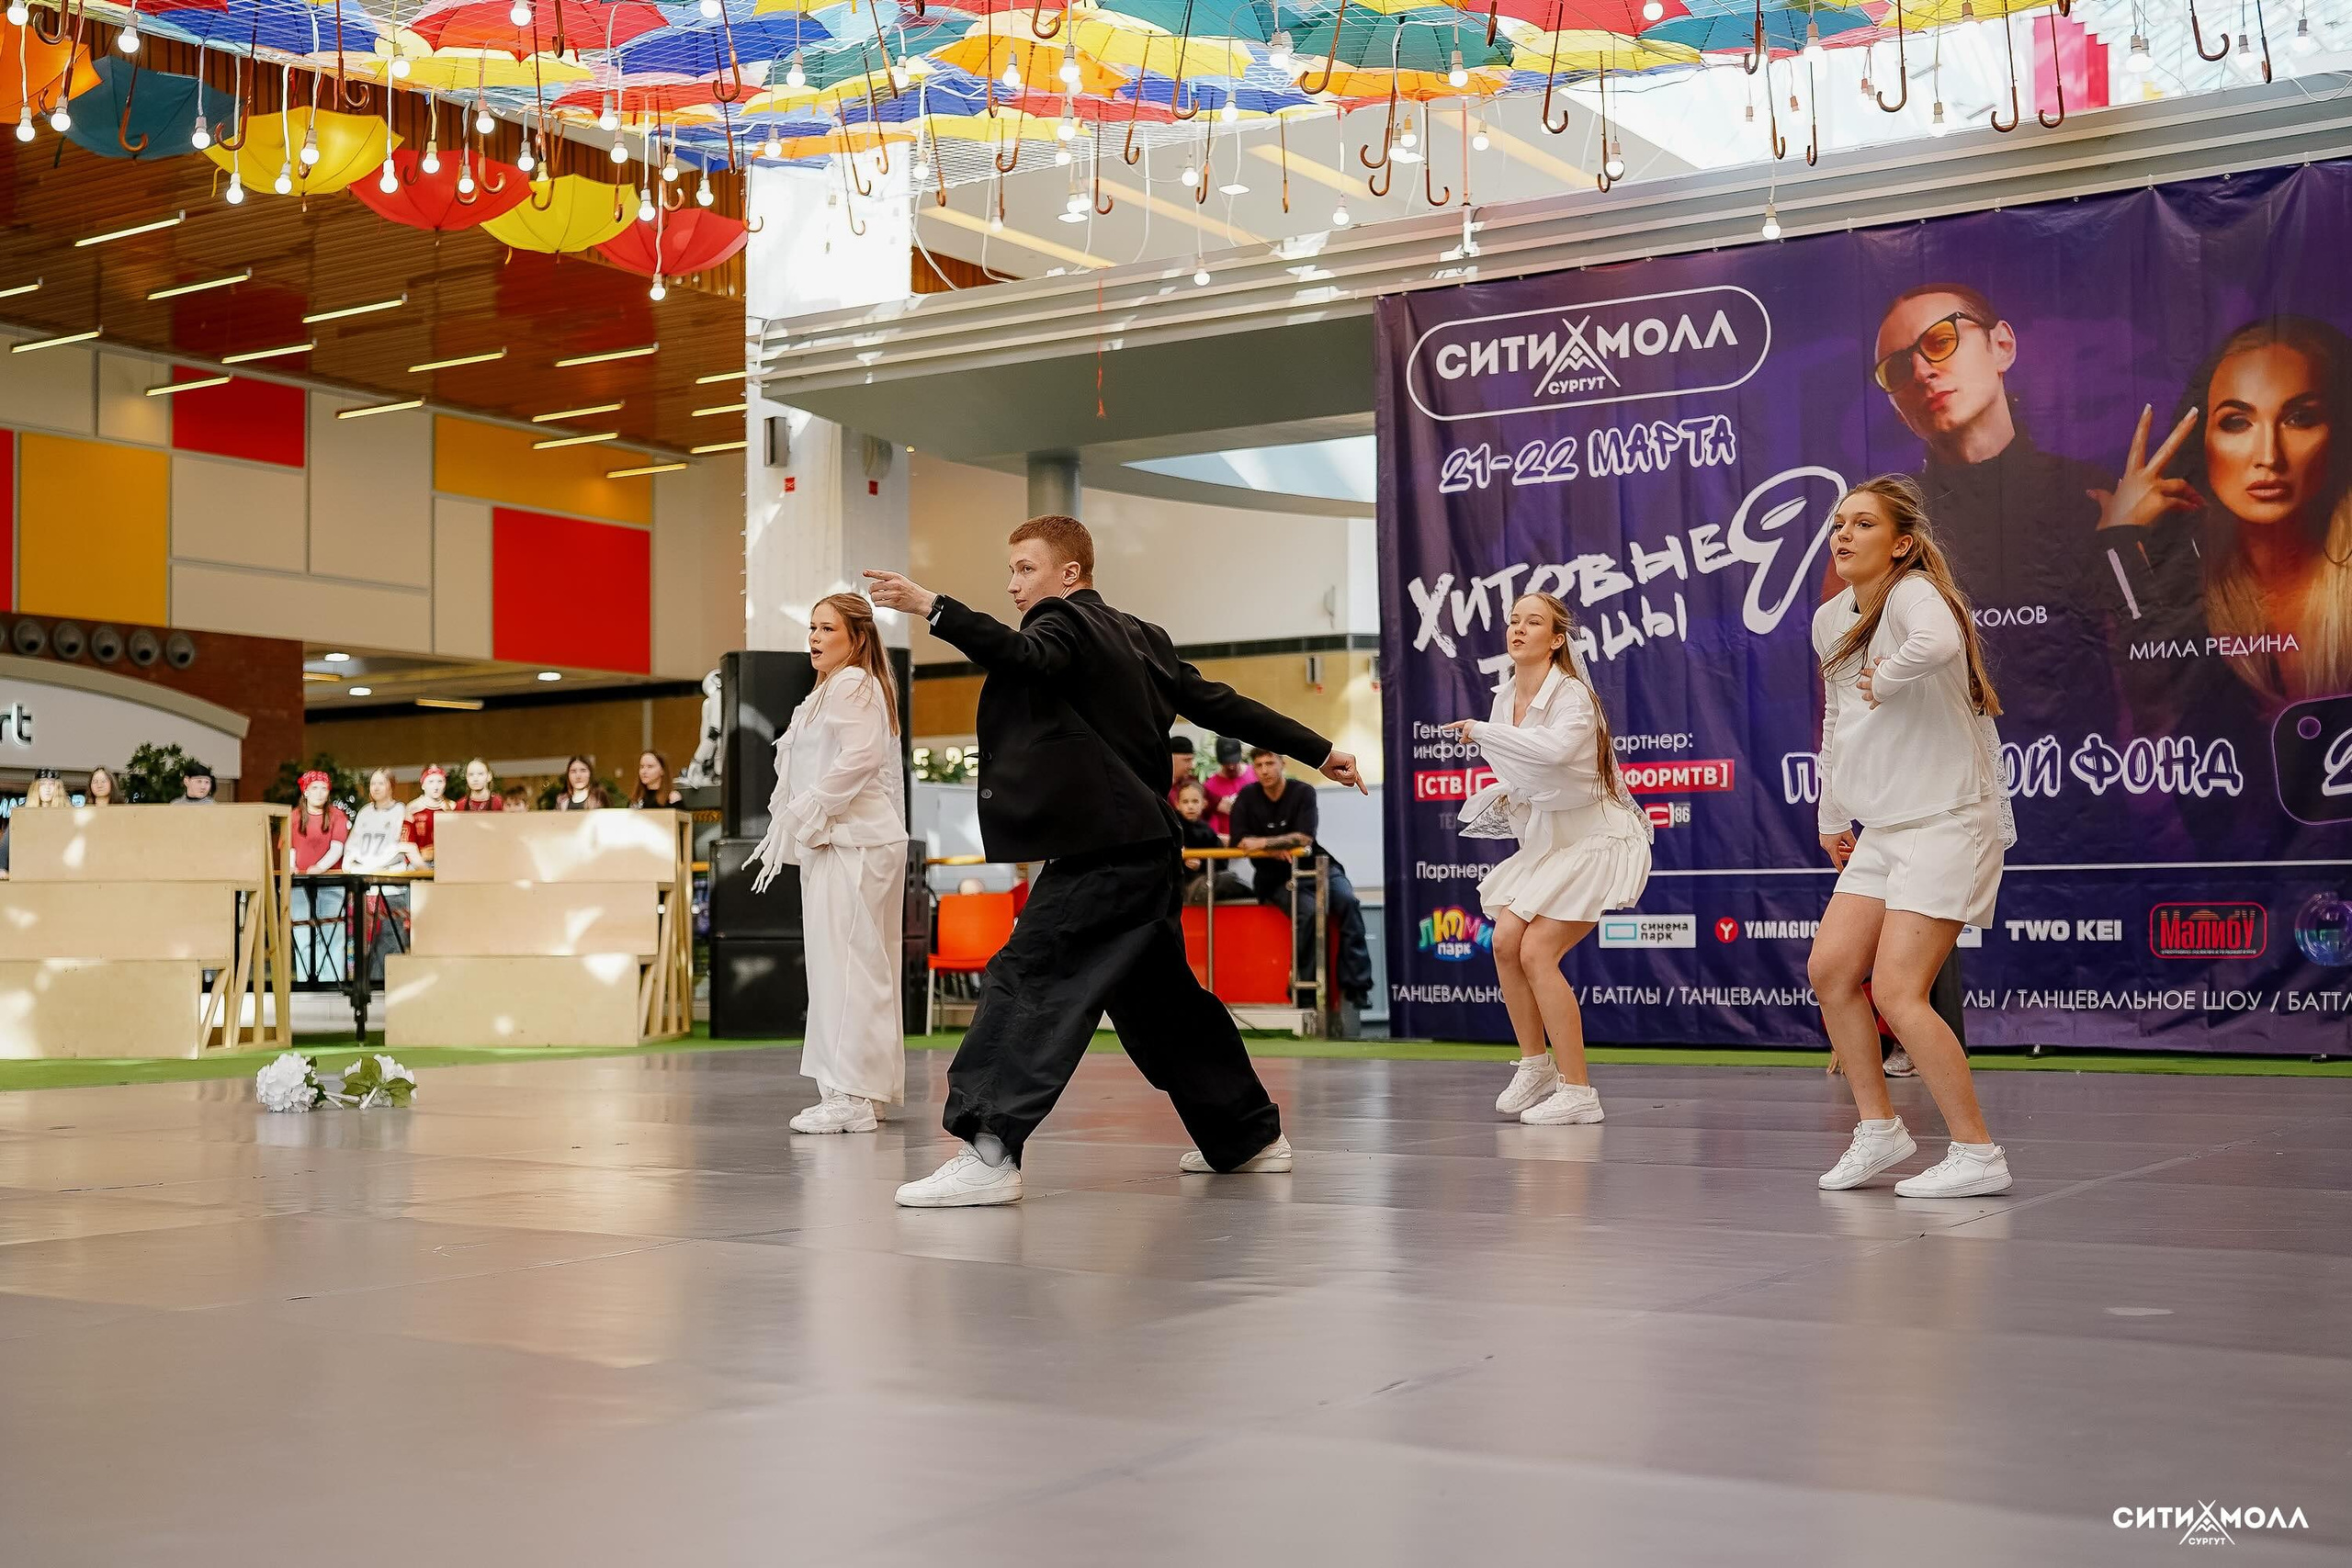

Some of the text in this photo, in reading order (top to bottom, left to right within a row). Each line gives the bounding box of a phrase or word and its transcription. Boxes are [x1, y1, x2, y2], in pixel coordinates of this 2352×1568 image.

[1548, 376, 1607, 396] СУРГУТ
[1439, 414, 1736, 494] 21-22 МАРТА
[1972, 605, 2048, 627] КОЛОВ
[2129, 633, 2300, 661] МИЛА РЕДИНА
[1413, 732, 1693, 762] инфор артнер:
[1416, 860, 1496, 883] Партнер
[1640, 920, 1689, 932] синема
[1745, 919, 1821, 940] YAMAGUC
[2005, 919, 2122, 942] TWO KEI
[1640, 931, 1673, 944] парк
[1438, 942, 1472, 958] парк
[1592, 985, 1661, 1006] БАТТЛЫ
[1679, 986, 1821, 1008] ТАНЦЕВАЛЬНО
[1962, 988, 1996, 1009] ЛЫ
[2017, 988, 2196, 1011] ТАНЦЕВАЛЬНОЕ
[2202, 989, 2263, 1010] ШОУ
[2288, 990, 2352, 1011] БАТТЛ
